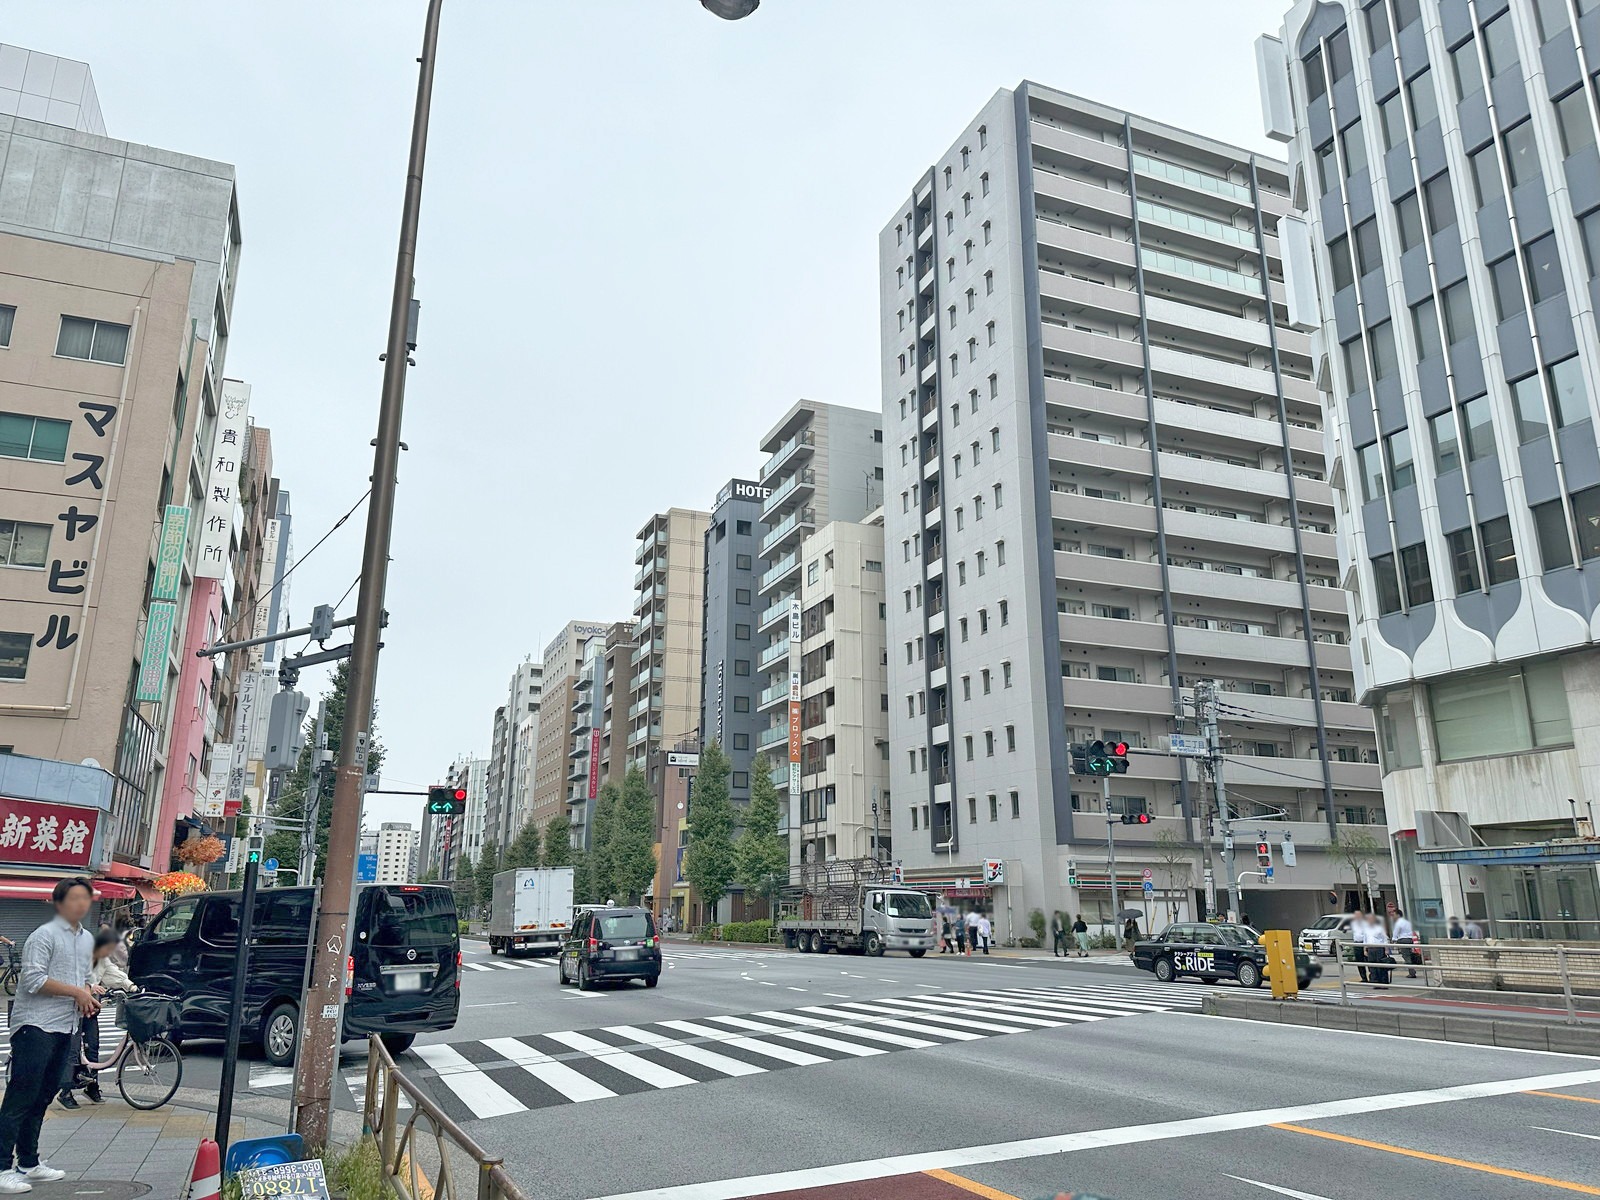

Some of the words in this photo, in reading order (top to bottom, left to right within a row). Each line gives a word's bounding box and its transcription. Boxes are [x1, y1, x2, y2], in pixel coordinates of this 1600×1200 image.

[203, 428, 237, 563] 貴和製作所
[736, 483, 773, 499] HOTE
[36, 401, 117, 649] マスヤビル
[158, 513, 186, 593] 季節の飾り
[141, 610, 171, 694] クリスマス用品
[574, 624, 606, 635] toyoko-
[236, 674, 256, 764] ホテルマーキュリー
[229, 767, 244, 799] 浅草橋
[0, 812, 90, 855] 新菜館
[1174, 956, 1216, 972] S.RIDE
